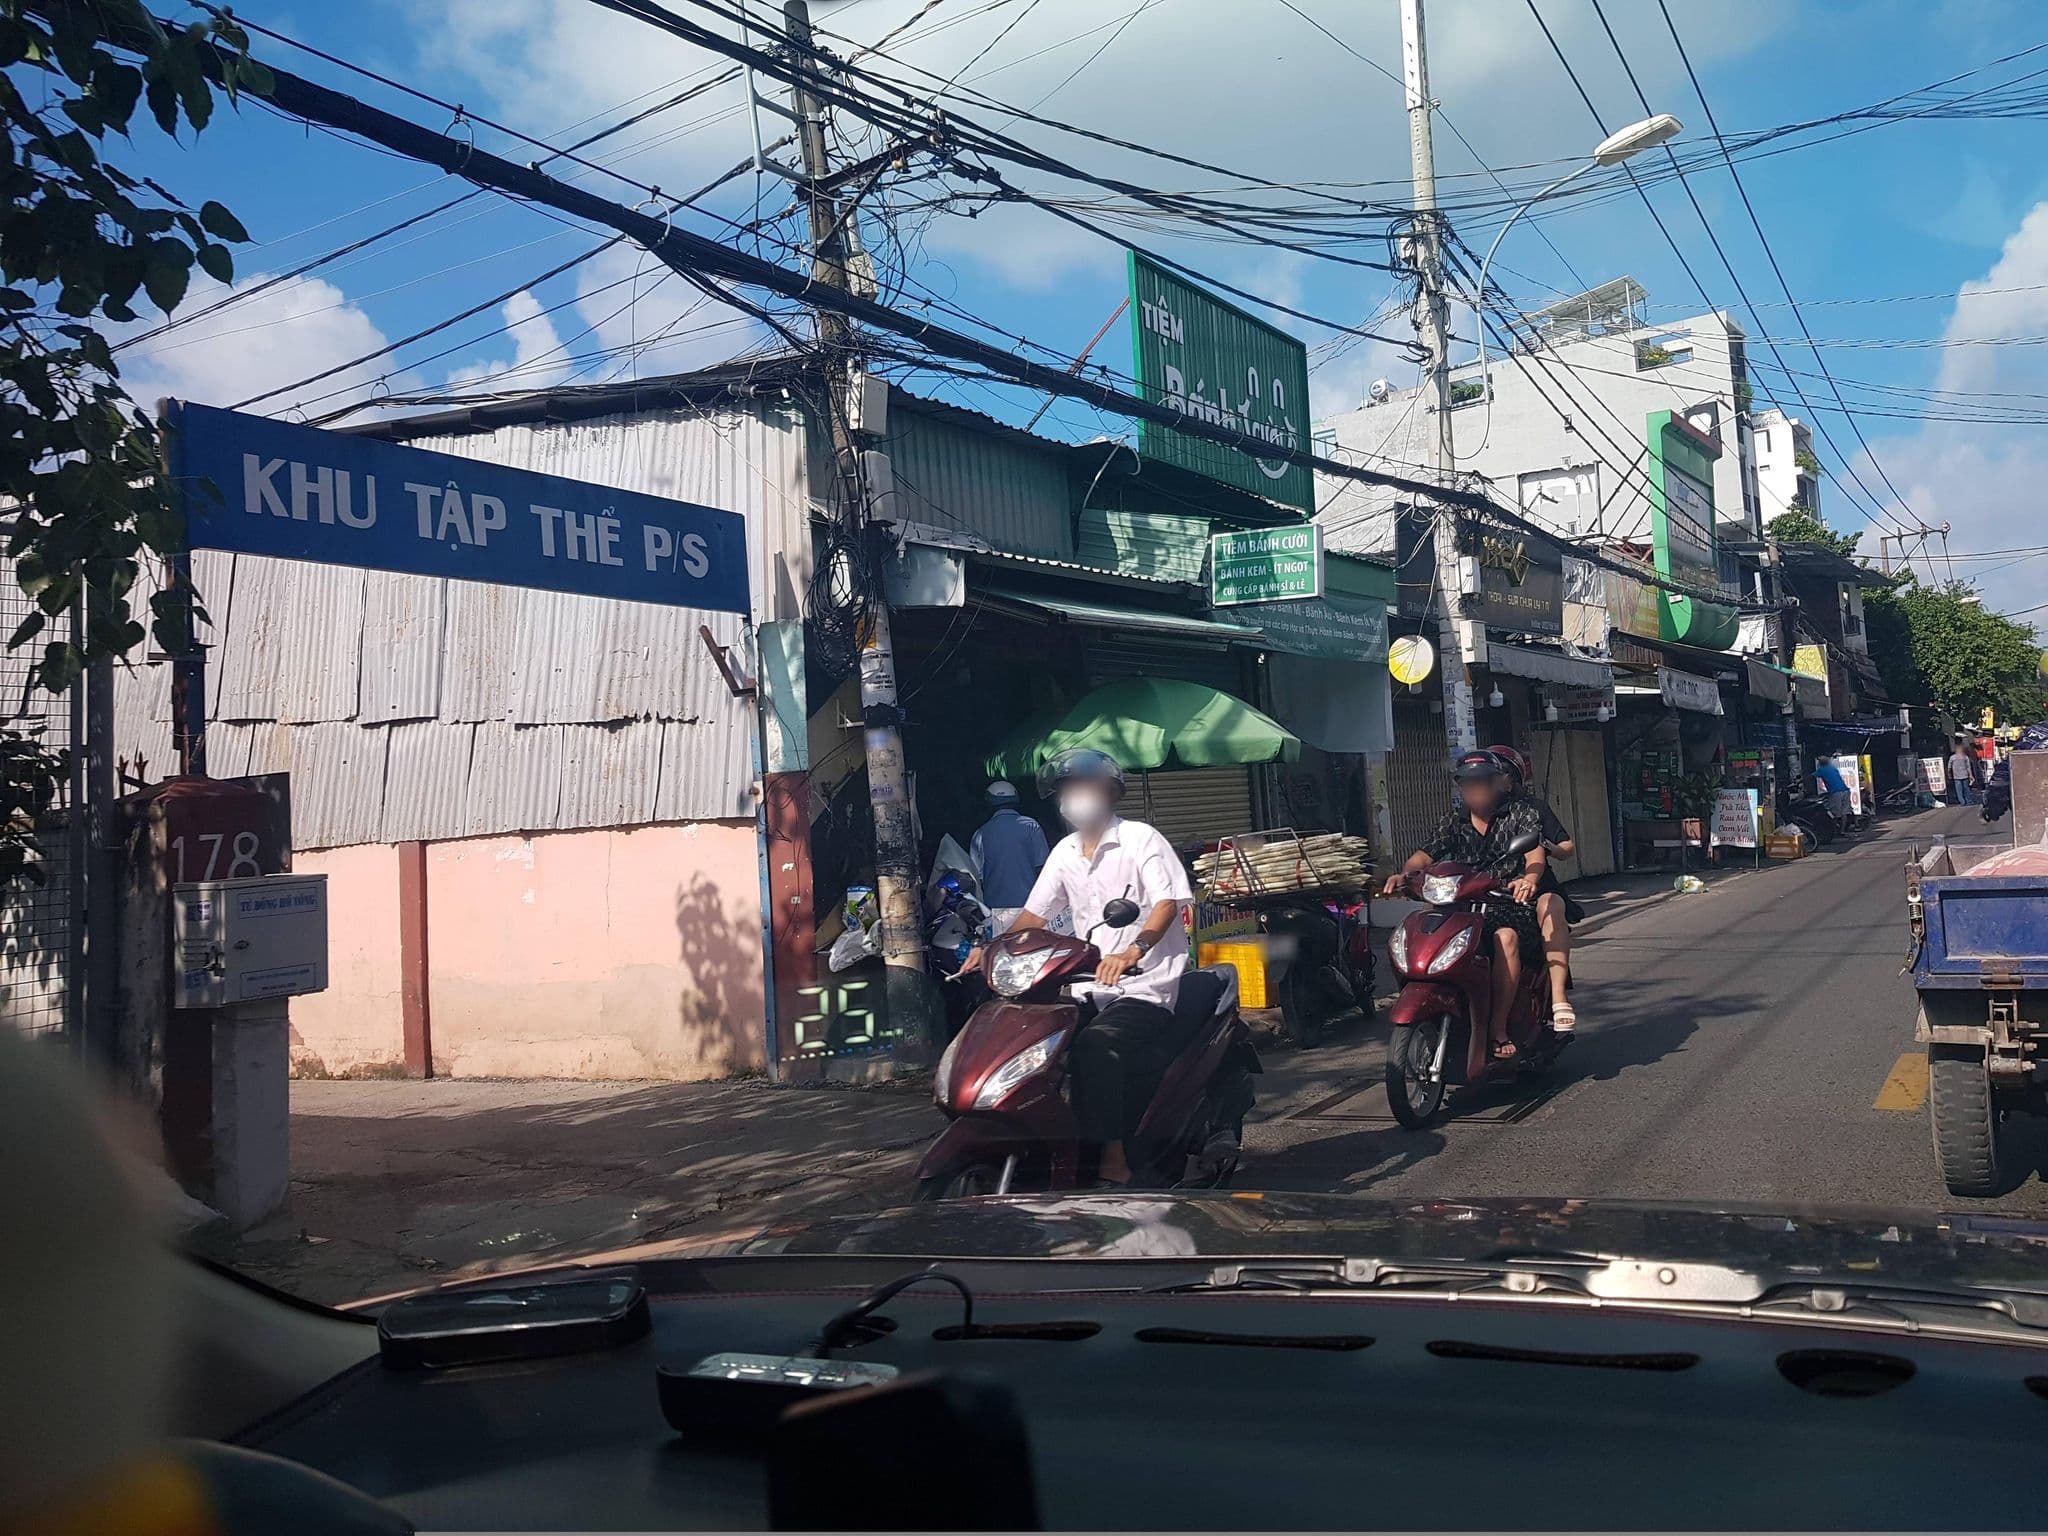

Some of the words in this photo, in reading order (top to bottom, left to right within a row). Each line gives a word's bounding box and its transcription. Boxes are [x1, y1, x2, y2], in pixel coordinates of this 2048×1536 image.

[1141, 295, 1184, 346] TIỆM
[243, 453, 376, 529] KHU
[404, 480, 507, 551] TẬP
[530, 506, 624, 567] THỂ
[643, 523, 710, 579] P/S
[1221, 541, 1247, 558] TIỆM
[1249, 536, 1280, 553] BÁNH
[1282, 532, 1308, 549] CƯỜI
[1220, 566, 1245, 580] BÁNH
[1247, 565, 1267, 577] KEM
[1284, 561, 1309, 575] NGỌT
[1222, 586, 1243, 596] CUNG
[1259, 582, 1280, 593] BÁNH
[1289, 581, 1296, 590] &
[172, 832, 262, 883] 178
